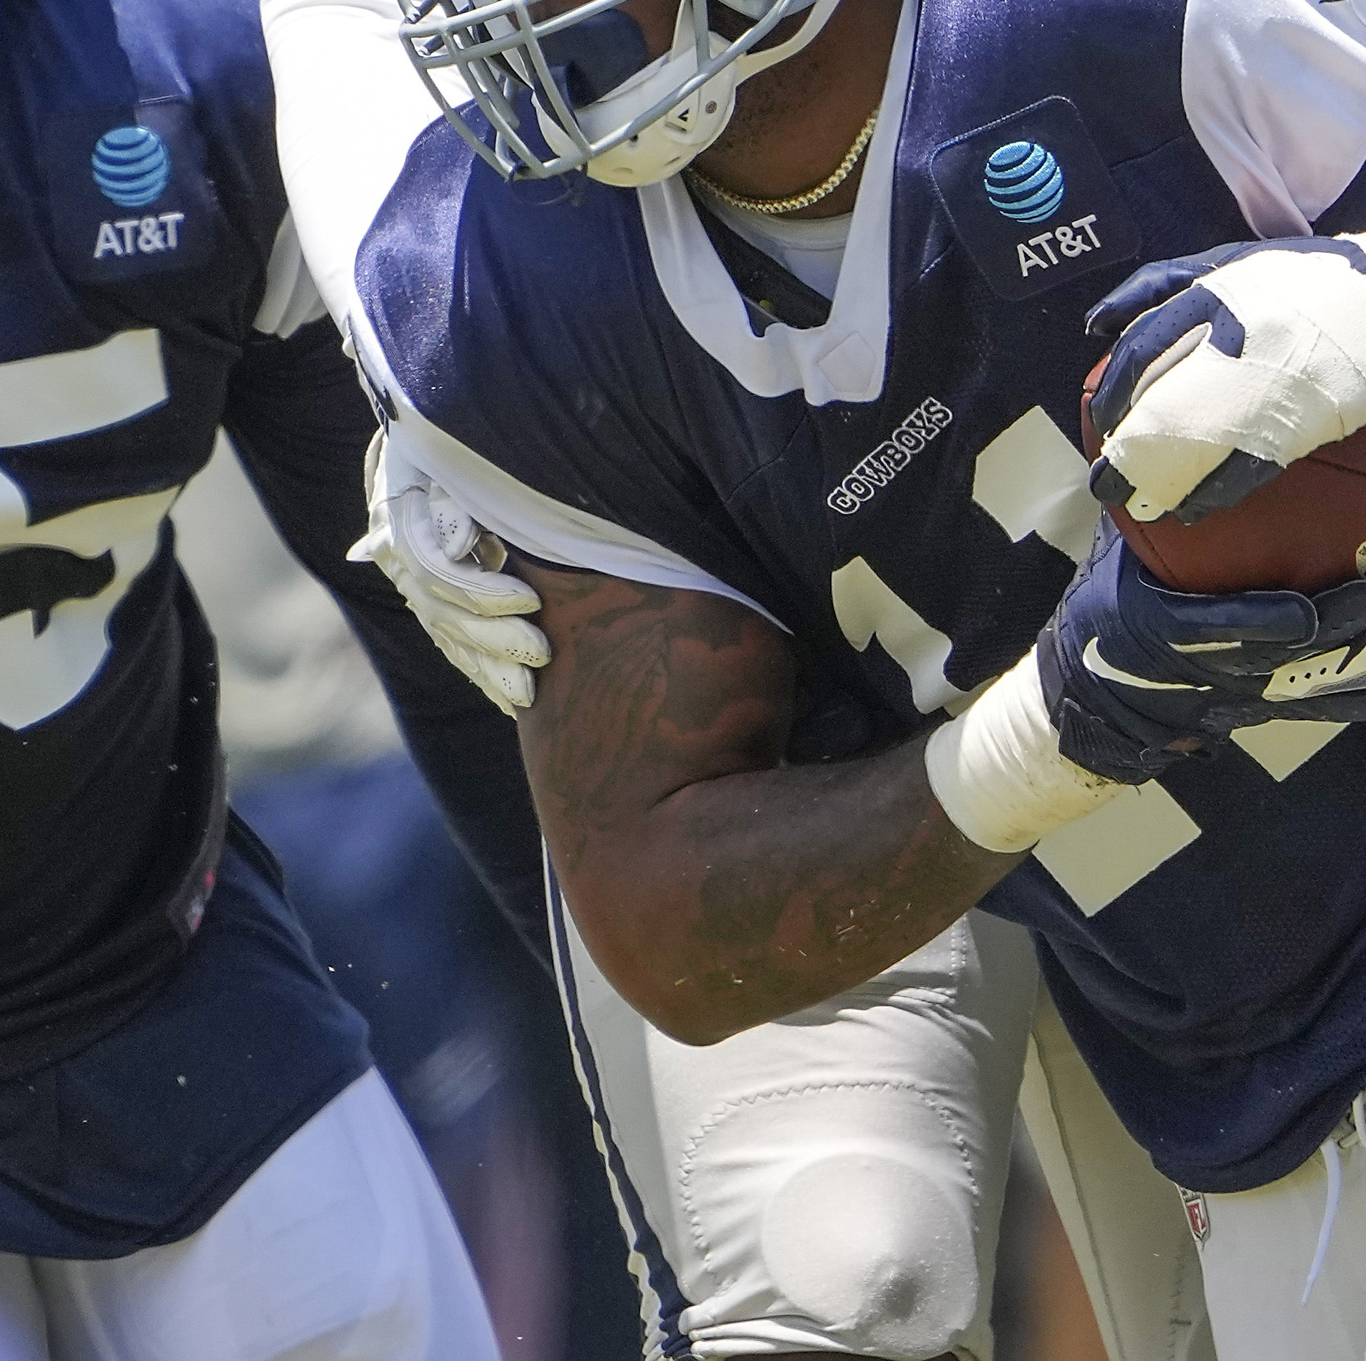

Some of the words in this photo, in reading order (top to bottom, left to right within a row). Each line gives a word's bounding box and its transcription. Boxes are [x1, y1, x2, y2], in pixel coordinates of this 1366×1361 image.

[93, 212, 185, 259] AT&T
[1016, 214, 1102, 277] AT&T
[826, 395, 953, 515] COWBOYS
